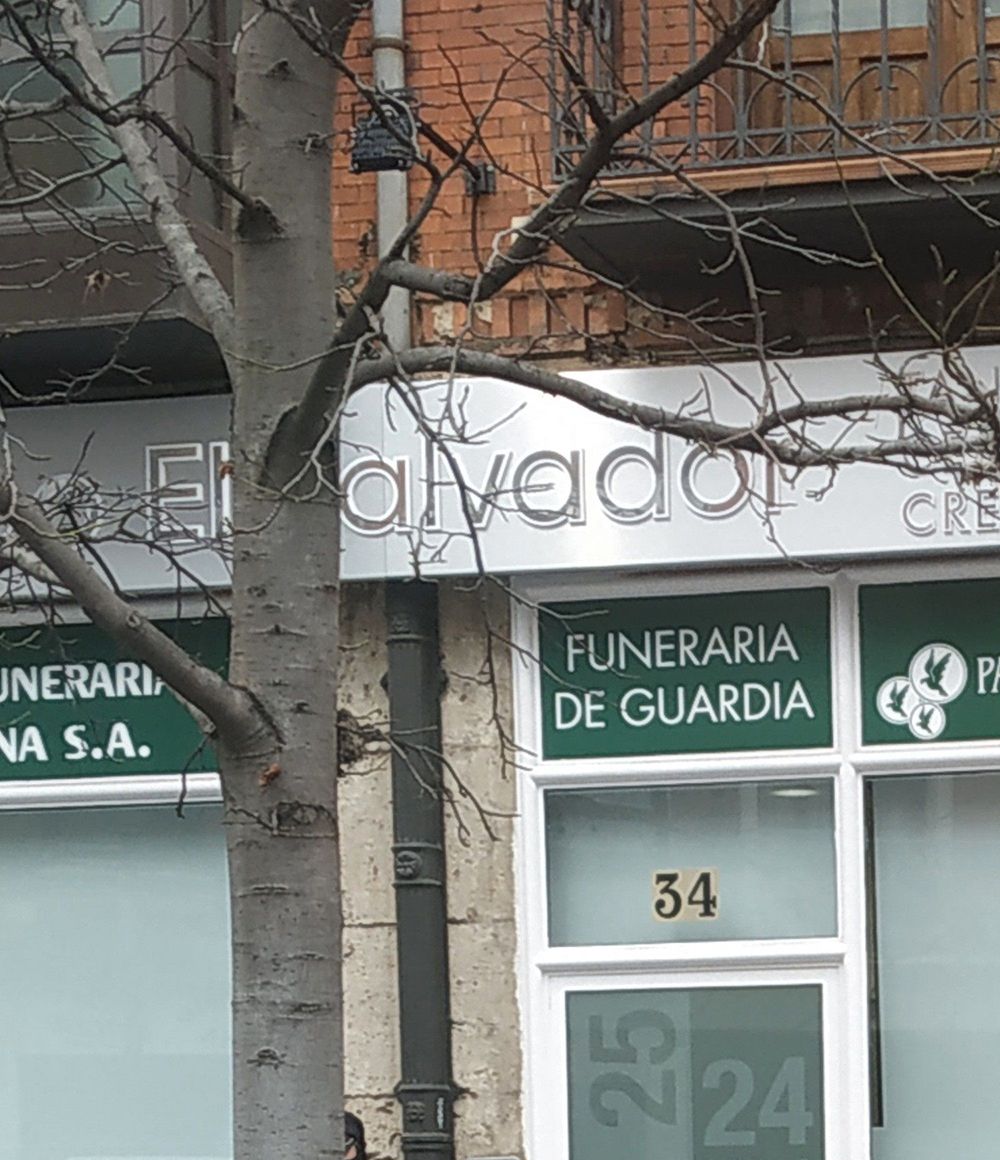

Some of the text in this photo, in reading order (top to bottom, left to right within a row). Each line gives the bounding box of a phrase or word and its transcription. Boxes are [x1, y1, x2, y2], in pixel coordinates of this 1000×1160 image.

[145, 430, 783, 545] El alvador
[566, 623, 800, 673] FUNERARIA
[554, 680, 816, 730] DE GUARDIA
[63, 721, 152, 760] S.A.
[653, 871, 718, 920] 34
[702, 1055, 815, 1148] 24
